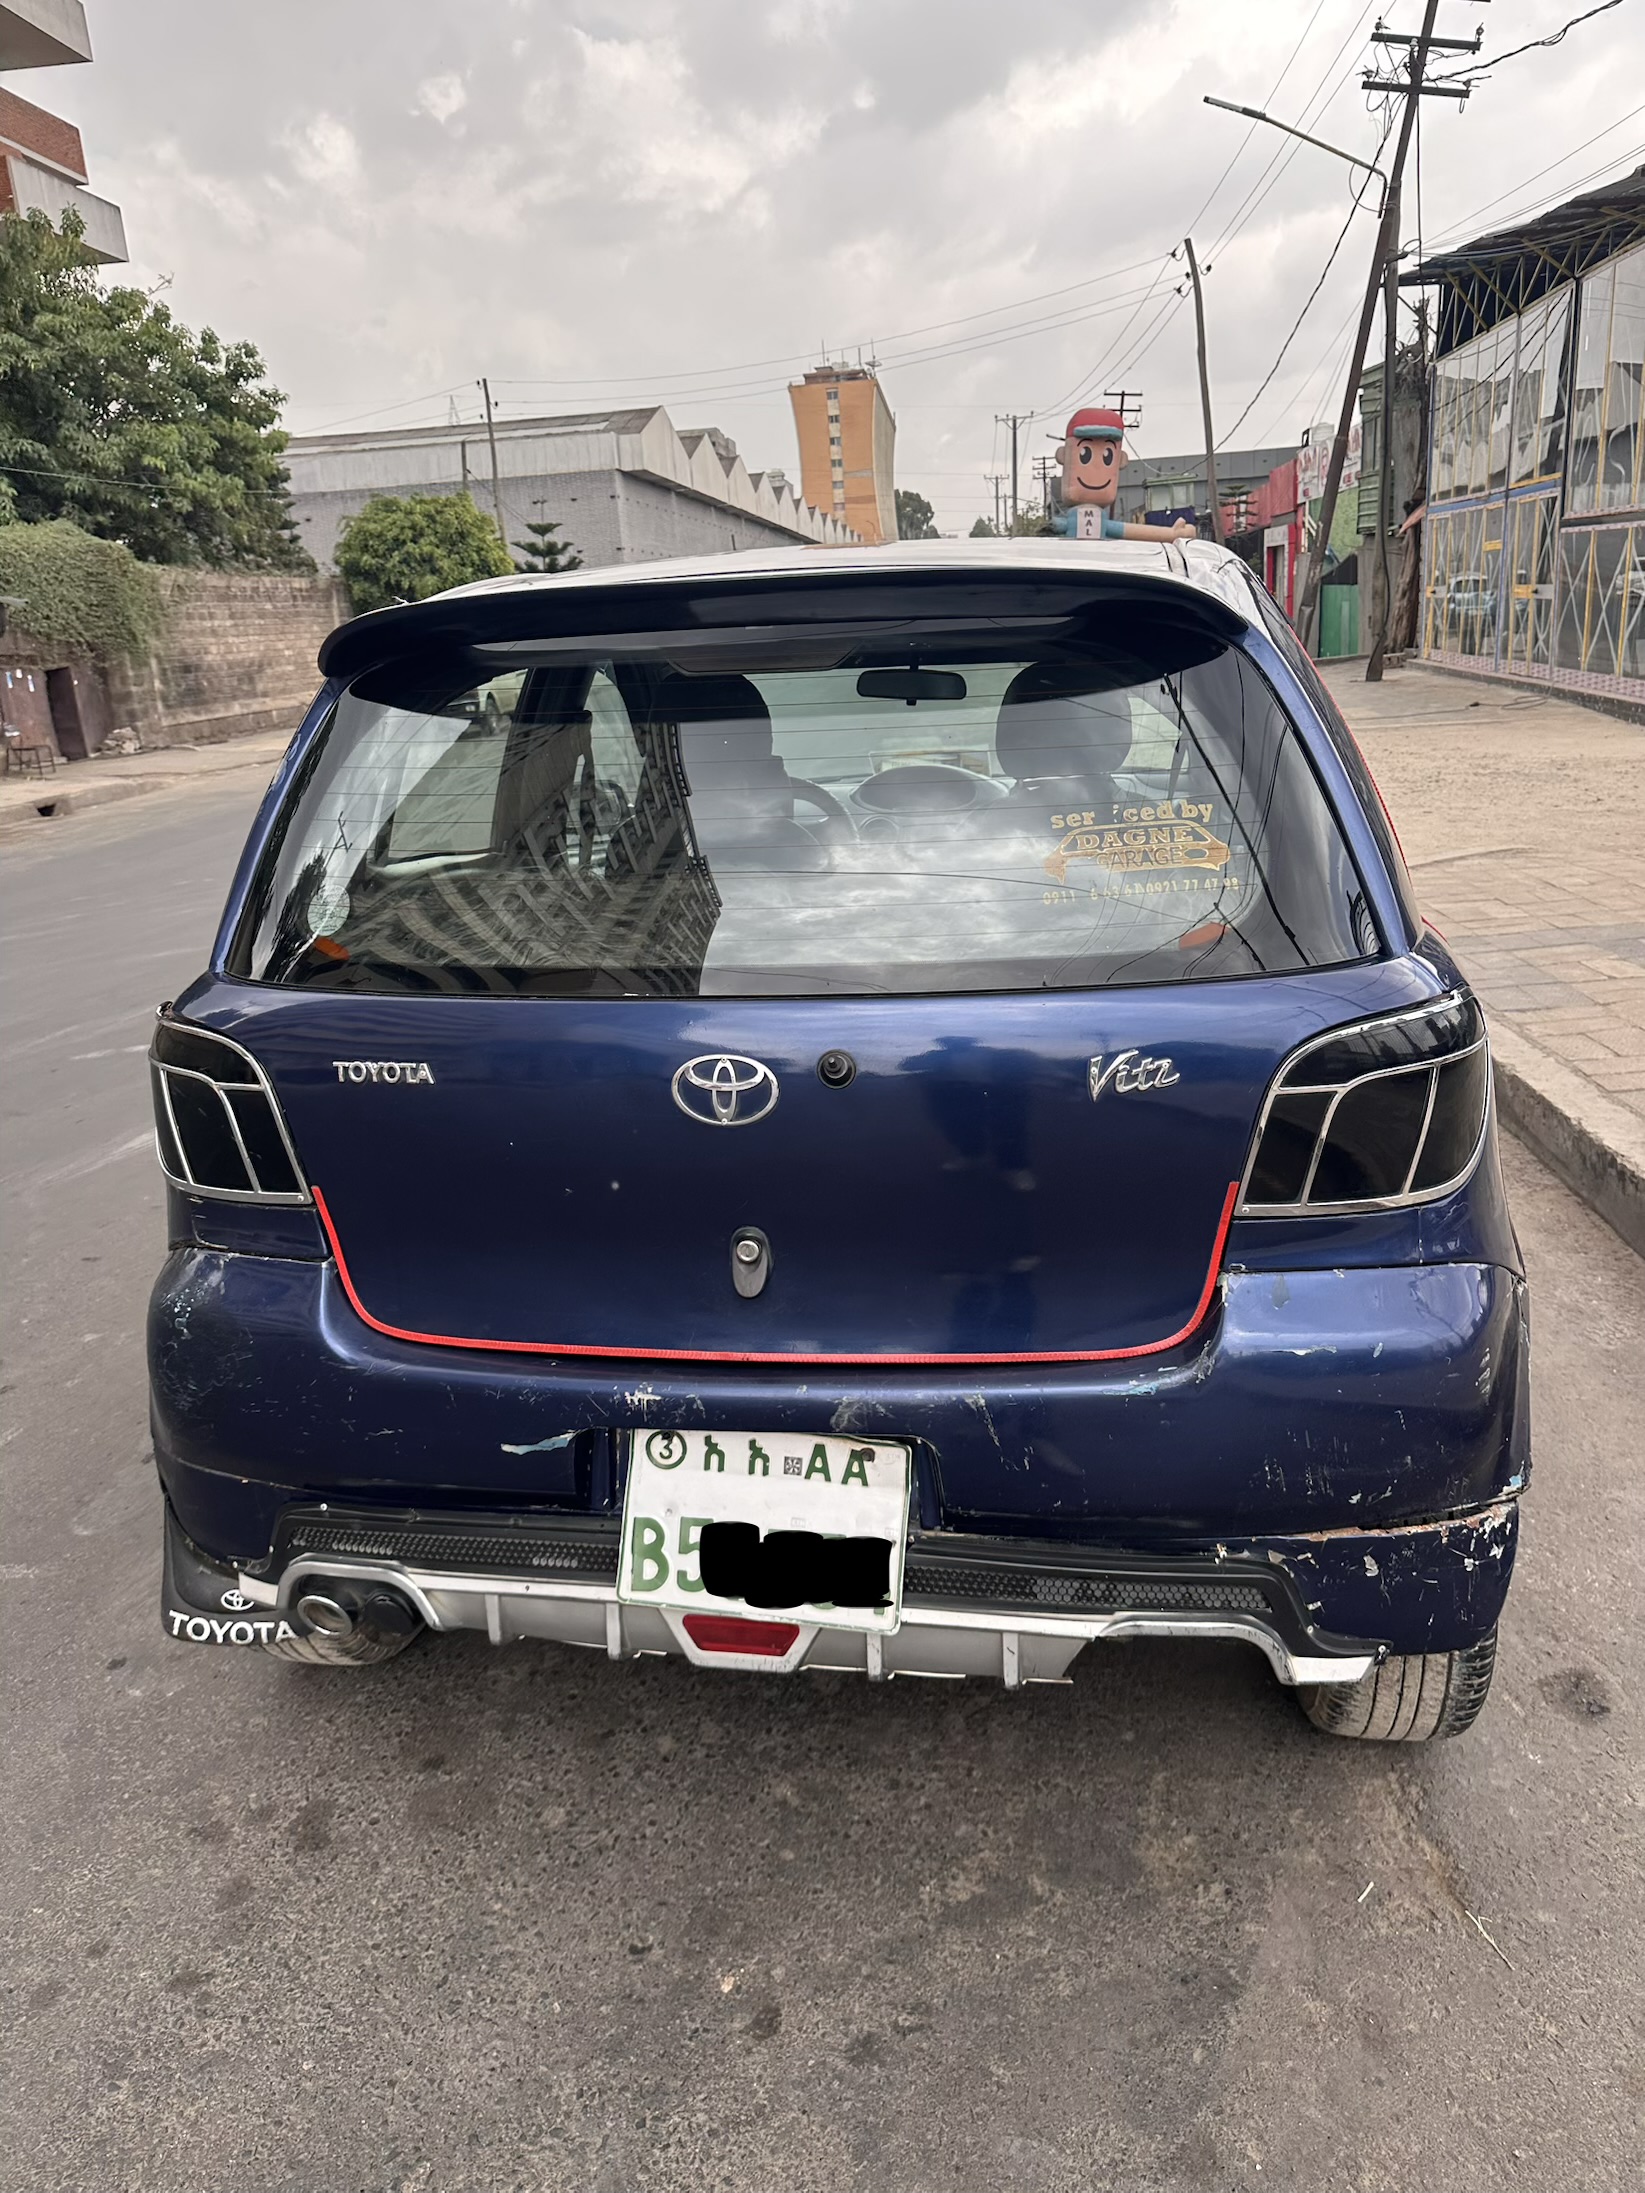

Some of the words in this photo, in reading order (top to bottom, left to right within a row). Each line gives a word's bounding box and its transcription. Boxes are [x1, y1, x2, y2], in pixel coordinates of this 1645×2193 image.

[1180, 800, 1214, 822] by
[1075, 826, 1193, 850] DAGNE
[1097, 847, 1183, 870] GARAGE
[1043, 890, 1076, 905] 0911
[1184, 879, 1199, 893] 77
[1204, 877, 1218, 891] 47
[333, 1061, 435, 1085] TOYOTA
[1088, 1049, 1180, 1102] Vitz
[804, 1443, 869, 1487] AA
[168, 1609, 297, 1645] TOYOTA
